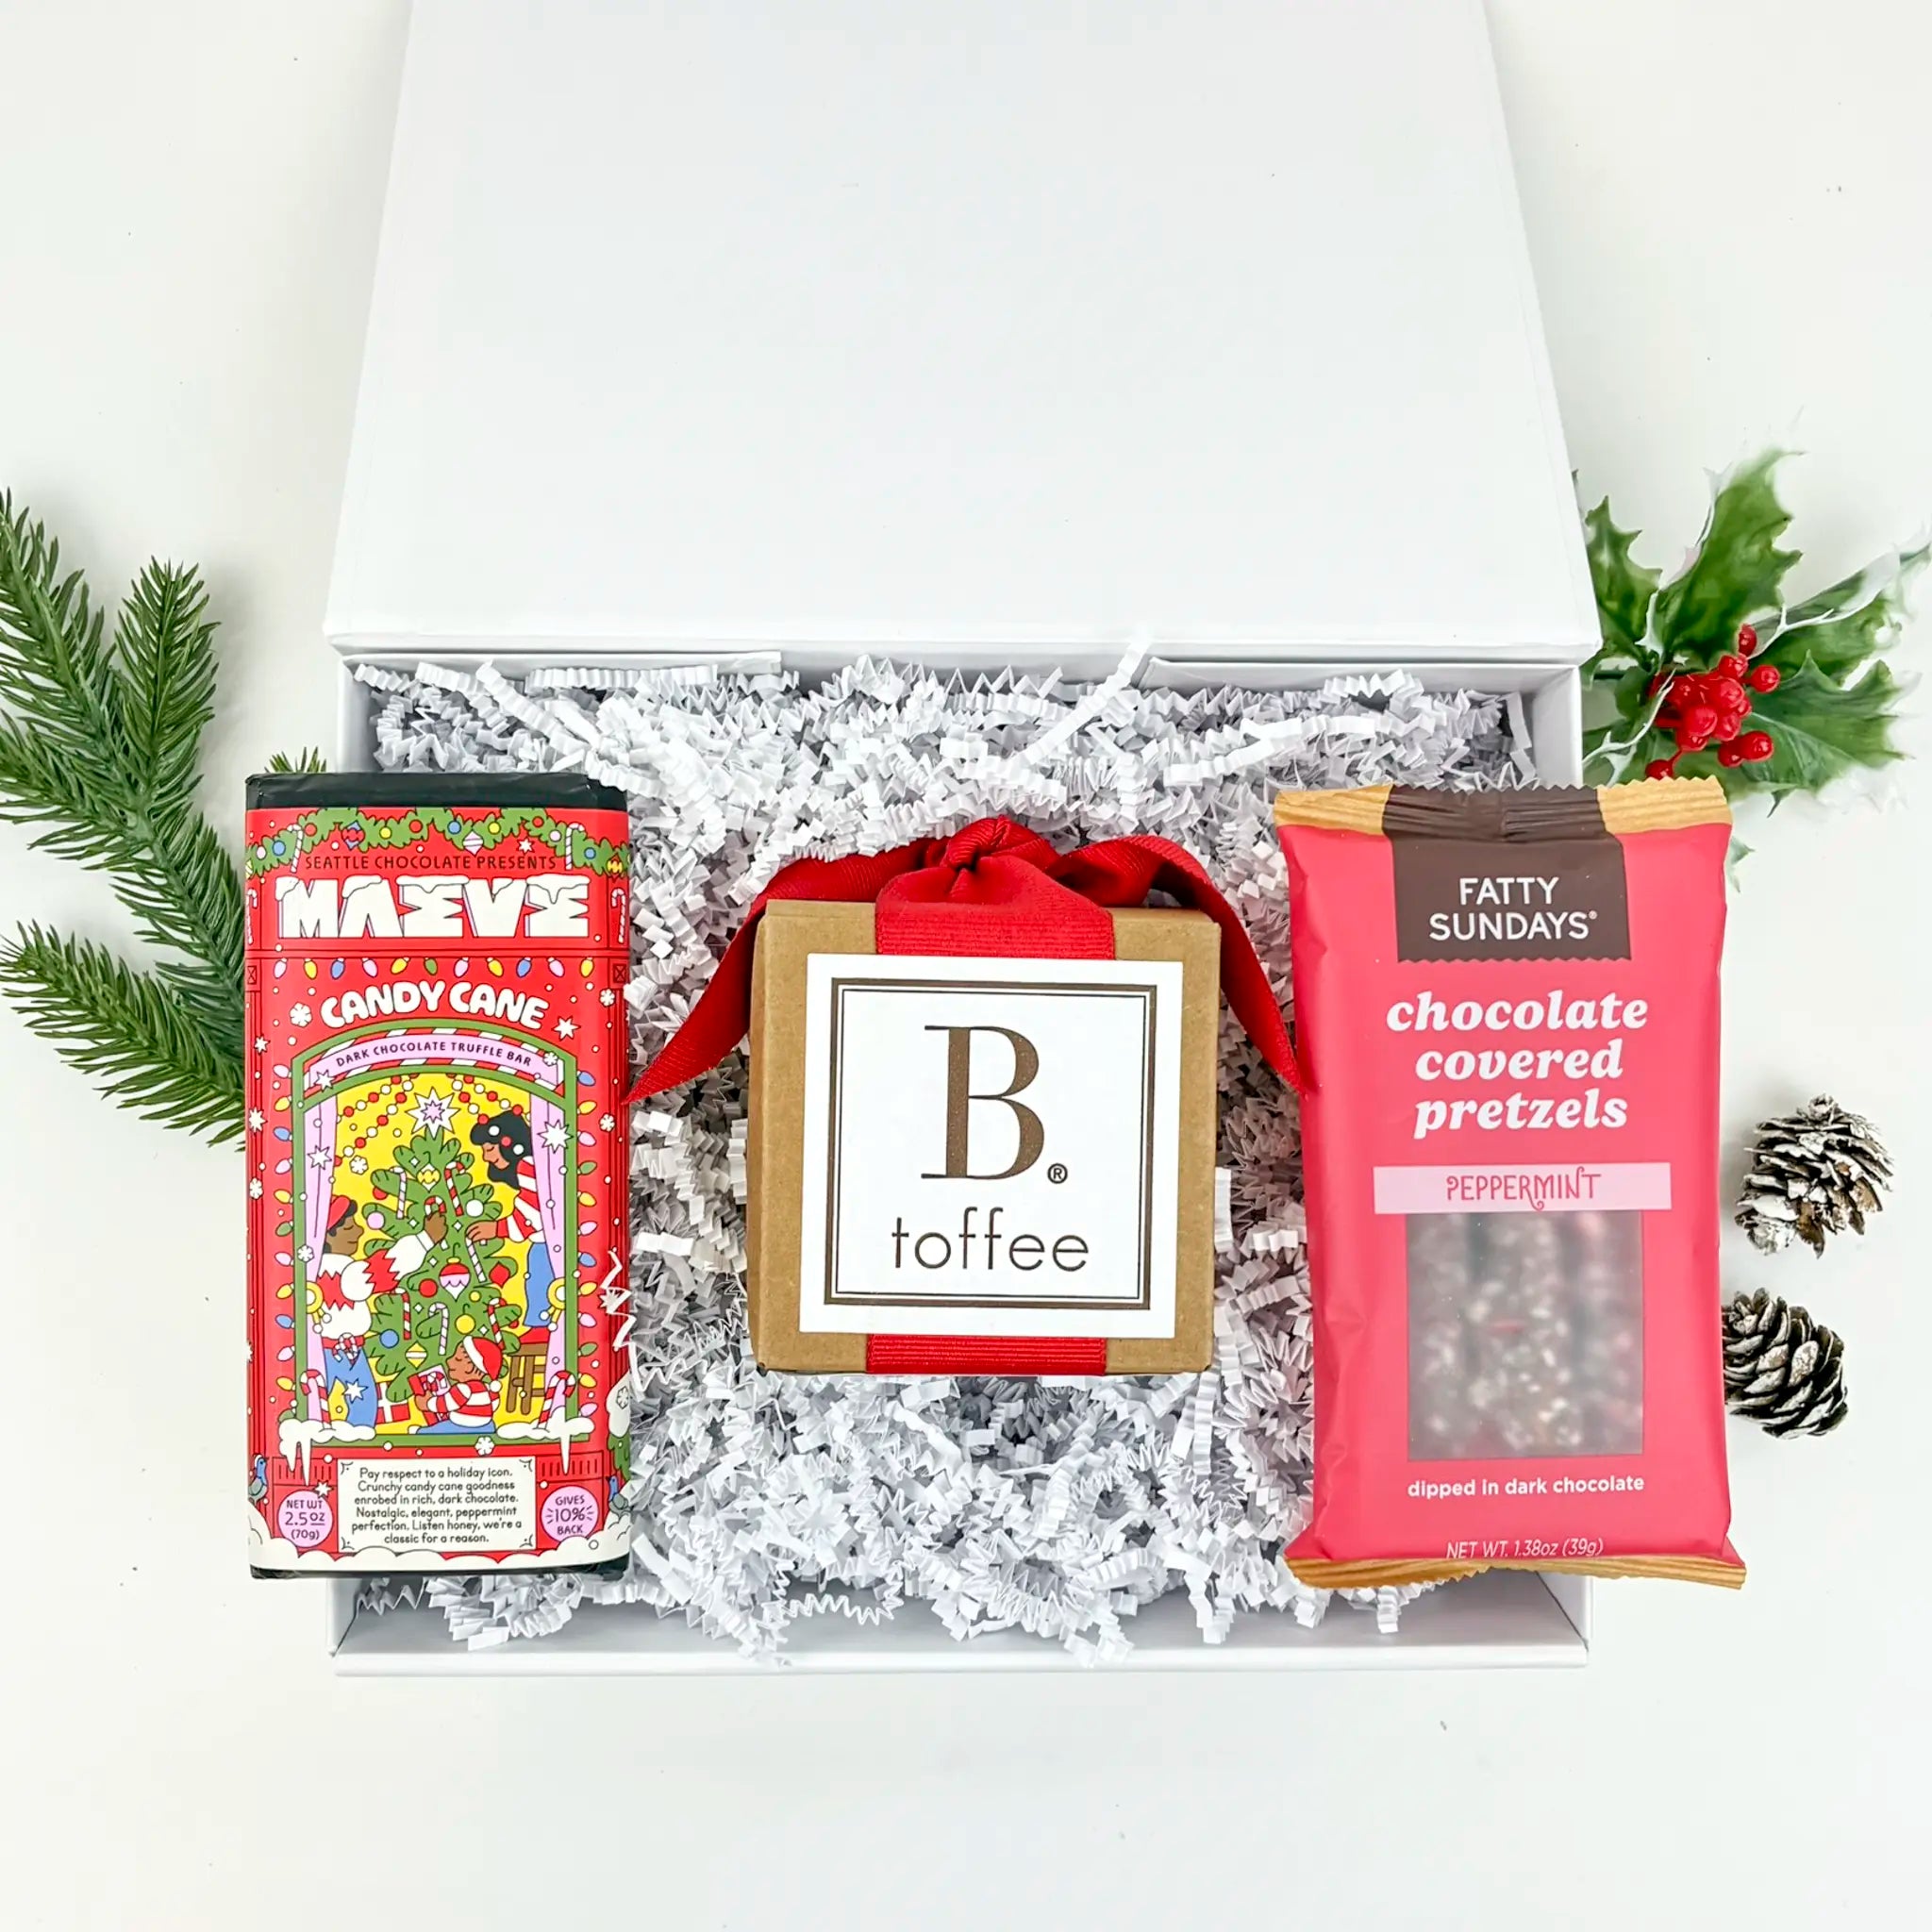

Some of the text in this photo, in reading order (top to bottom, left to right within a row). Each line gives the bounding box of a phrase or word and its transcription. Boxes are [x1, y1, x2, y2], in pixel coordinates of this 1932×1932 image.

[306, 856, 557, 869] SEATTLE CHOCOLATE PRESENTS
[1458, 876, 1559, 905] FATTY
[275, 874, 591, 938] MAEVE
[320, 980, 549, 1029] CANDY CANE
[1386, 990, 1648, 1032] chocolate
[336, 1041, 532, 1067] DARK CHOCOLATE TRUFFLE BAR
[1414, 1038, 1624, 1080] covered
[1413, 1088, 1628, 1140] pretzels
[1446, 1166, 1601, 1211] PEPPERMINT
[891, 1207, 1089, 1272] toffee
[359, 1467, 379, 1482] Pay
[382, 1469, 422, 1482] respect
[425, 1468, 436, 1478] to
[447, 1467, 486, 1481] holiday
[358, 1480, 515, 1495] Crunchy candy cane goodness
[1407, 1475, 1644, 1499] dipped in dark chocolate
[286, 1500, 323, 1509] NET WT
[354, 1494, 397, 1505] enrobed
[400, 1494, 409, 1505] in
[438, 1493, 462, 1504] dark
[555, 1495, 585, 1506] GIVES
[285, 1511, 325, 1526] 2.5 oz
[456, 1507, 517, 1521] peppermint
[556, 1507, 585, 1523] 10%
[412, 1521, 444, 1530] Listen
[483, 1518, 512, 1529] we're
[557, 1524, 583, 1535] BACK
[291, 1529, 320, 1541] (70g)
[384, 1533, 419, 1543] classic
[422, 1533, 439, 1543] for
[1446, 1538, 1604, 1558] NET WT. 1.38oz (39g)
